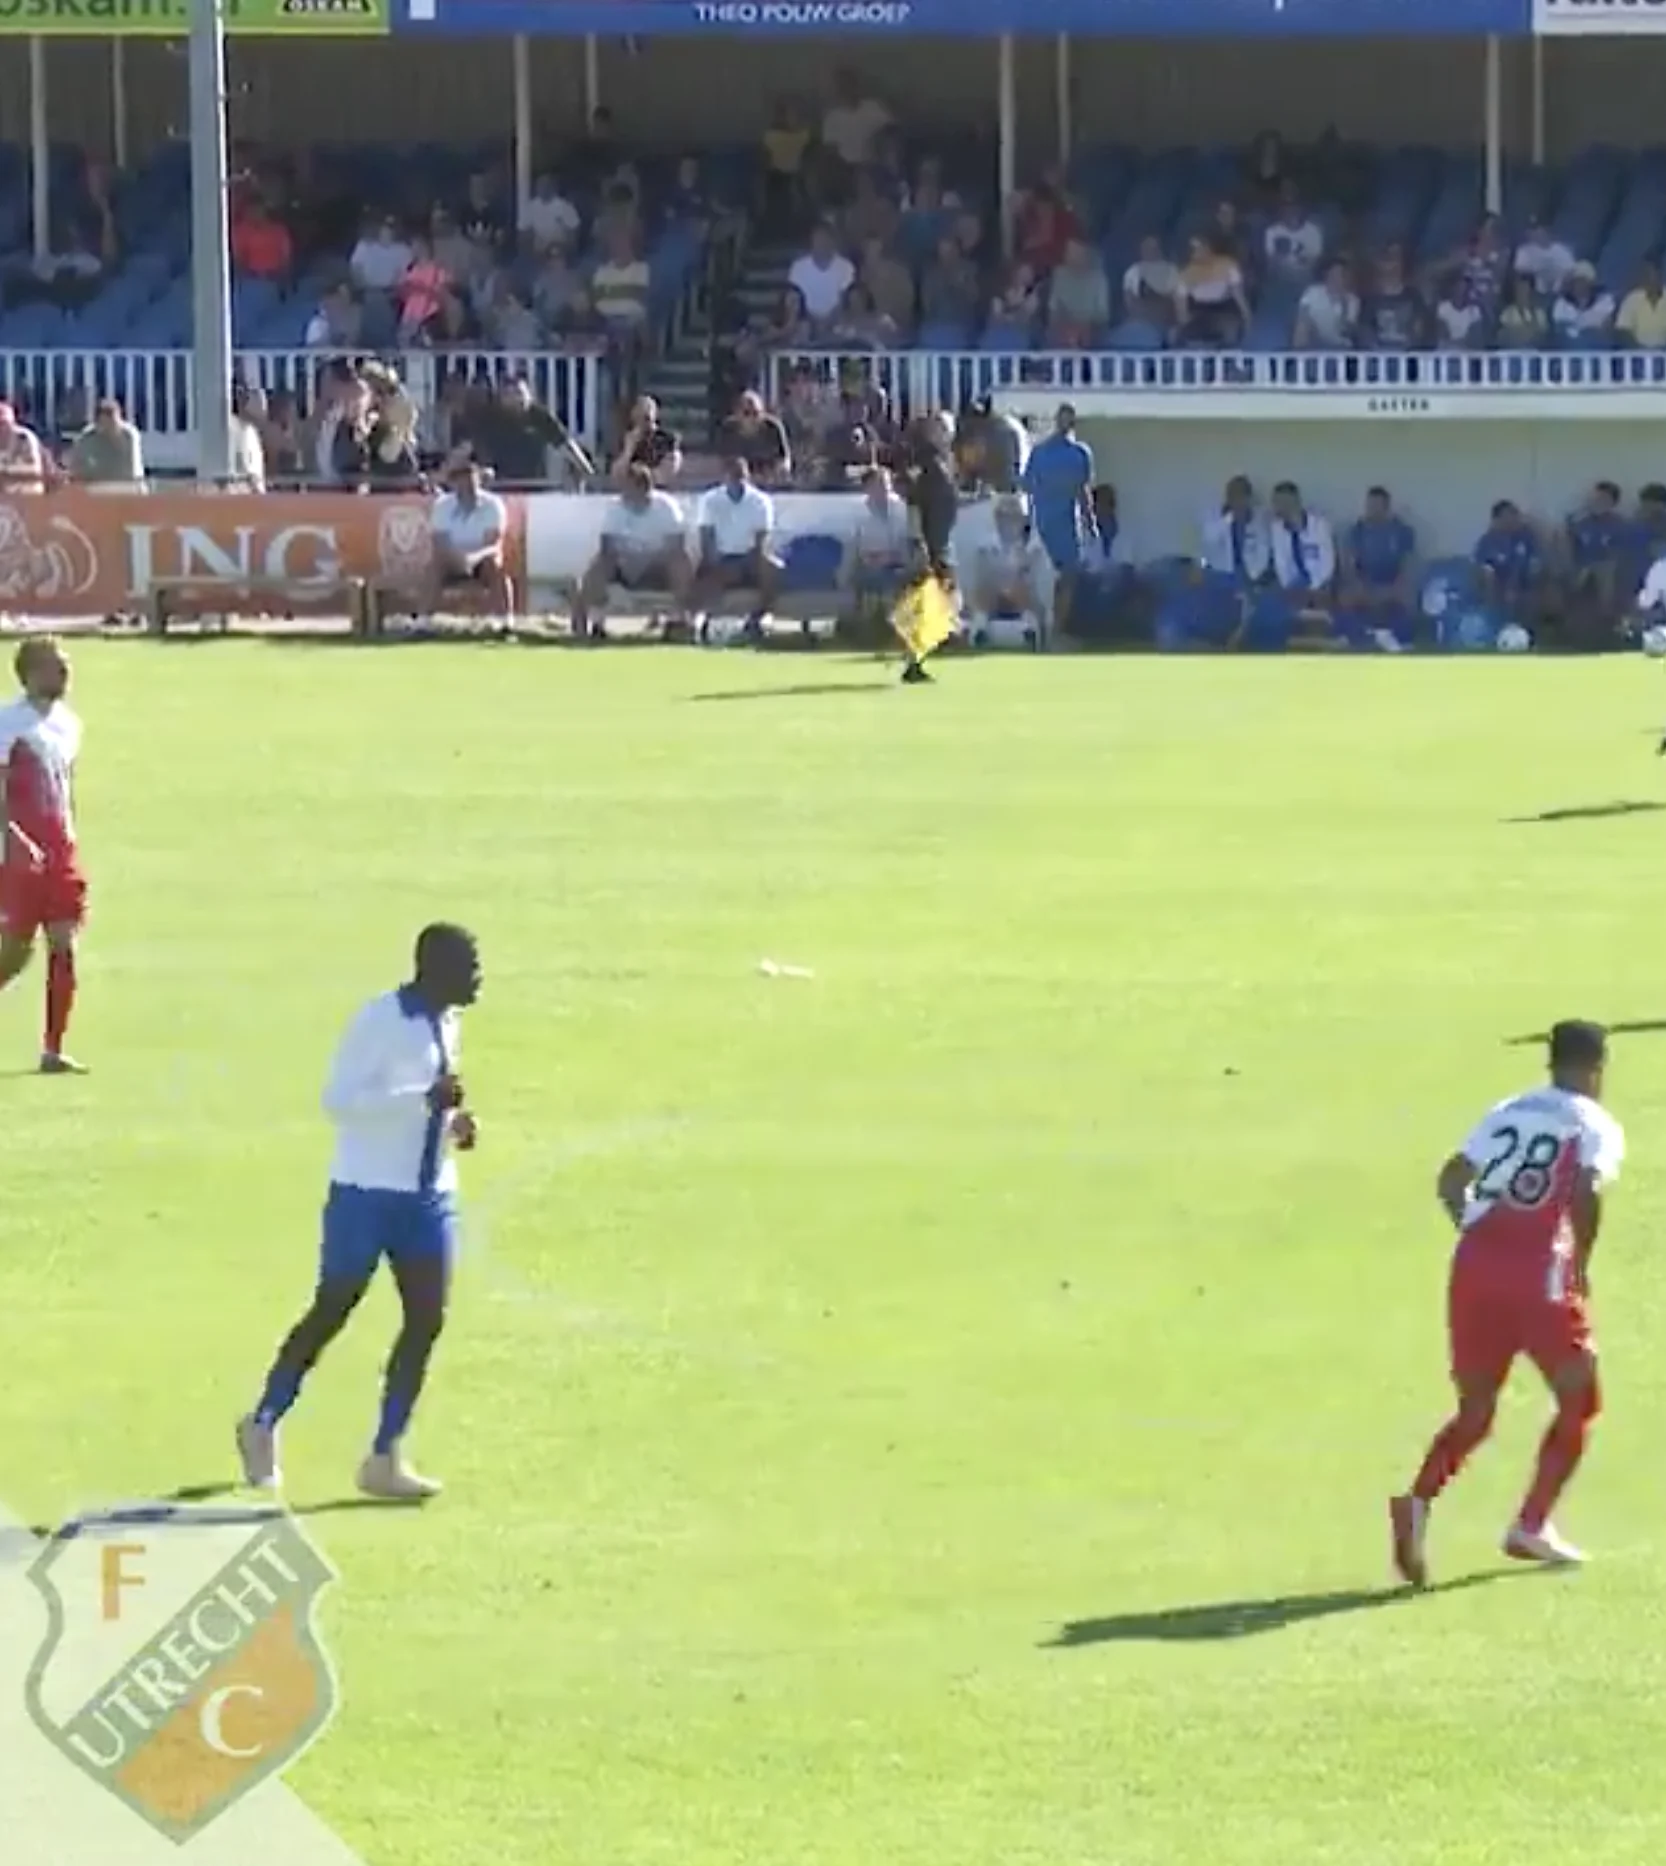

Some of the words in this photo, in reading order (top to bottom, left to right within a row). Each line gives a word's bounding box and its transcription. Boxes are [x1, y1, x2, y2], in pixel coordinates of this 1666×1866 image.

[696, 2, 757, 22] THEO
[763, 2, 830, 22] POUW
[836, 2, 911, 22] GROEP
[124, 523, 342, 598] ING
[1473, 1124, 1560, 1205] 28
